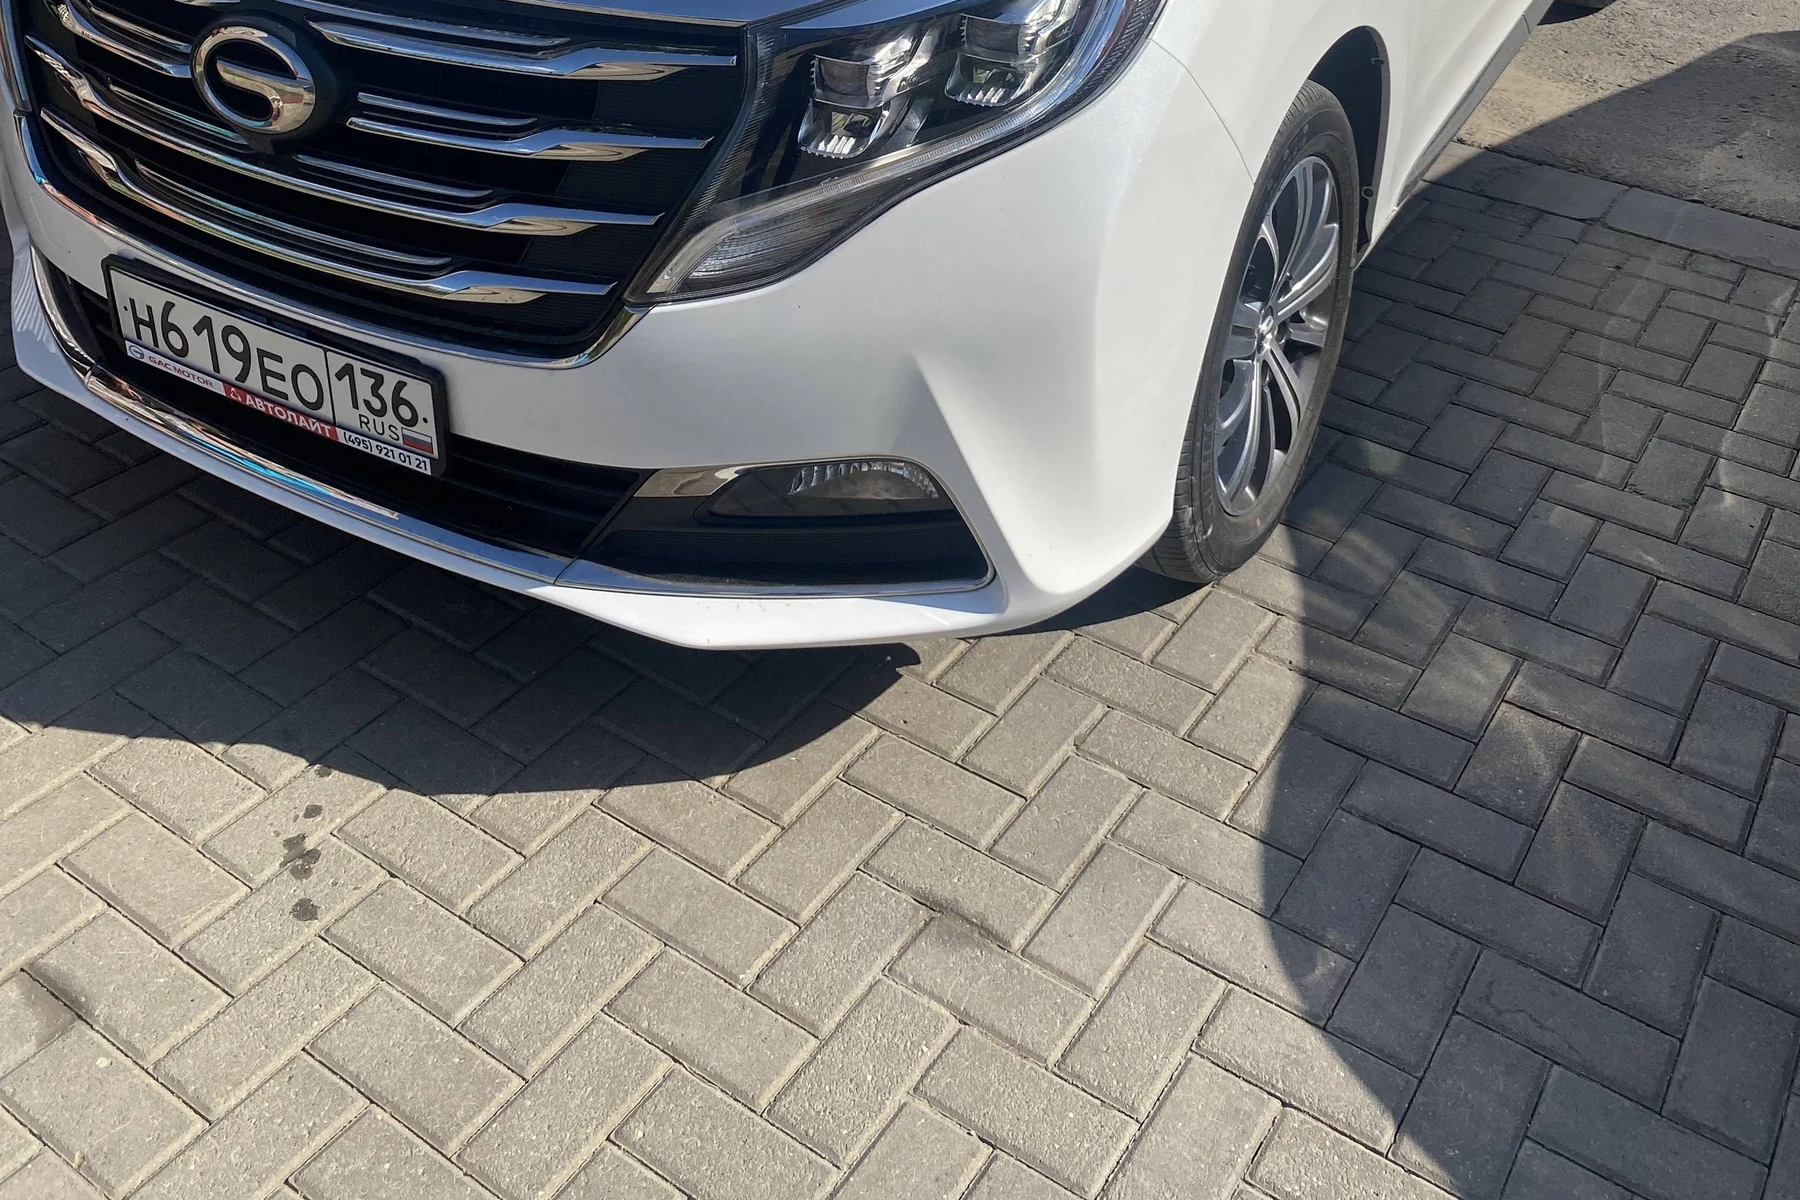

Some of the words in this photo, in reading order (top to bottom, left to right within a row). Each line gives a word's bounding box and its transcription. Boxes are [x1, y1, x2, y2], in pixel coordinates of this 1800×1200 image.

[128, 296, 324, 411] Н619ЕО
[334, 362, 419, 428] 136
[148, 355, 173, 371] GAC
[172, 365, 214, 388] MOTOR
[245, 393, 331, 438] АВТОЛАЙТ
[358, 413, 400, 442] RUS
[343, 431, 373, 453] (495)
[375, 443, 396, 460] 921
[398, 452, 412, 466] 01
[415, 458, 428, 472] 21
